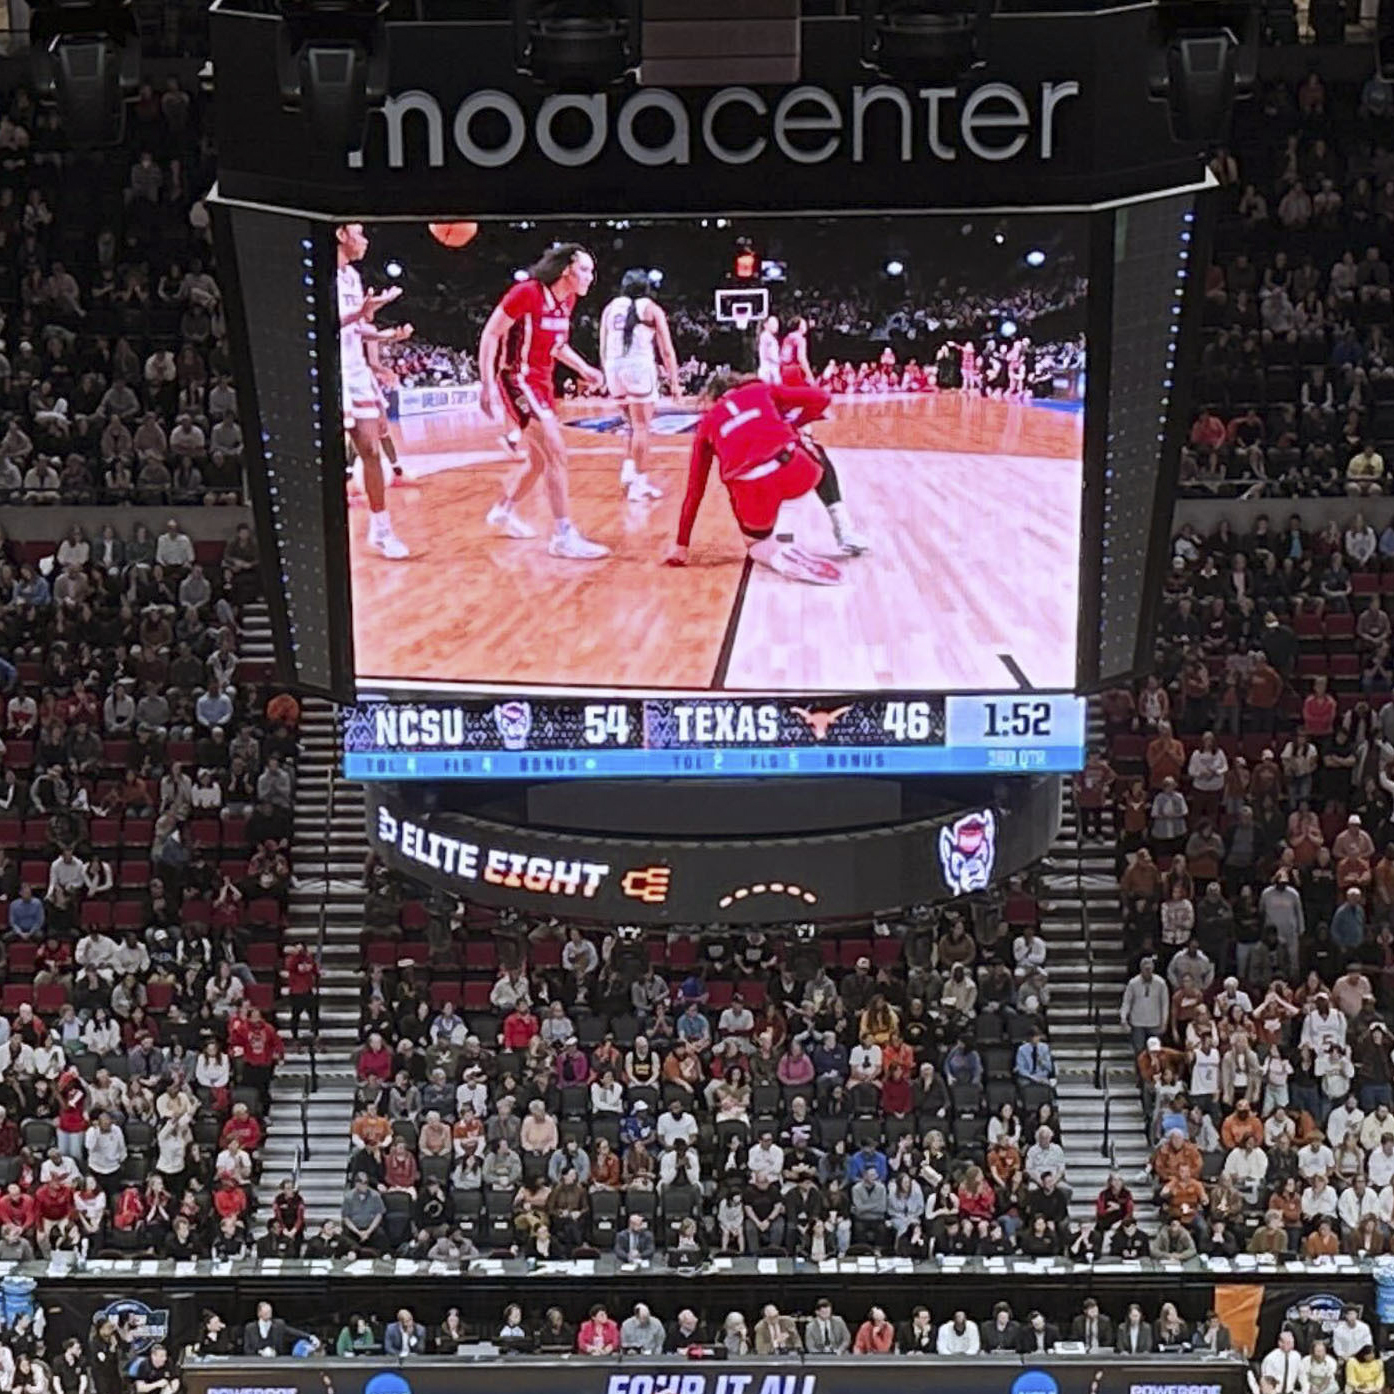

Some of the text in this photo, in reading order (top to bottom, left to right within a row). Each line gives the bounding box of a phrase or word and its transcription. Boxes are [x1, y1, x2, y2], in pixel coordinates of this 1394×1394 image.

[376, 707, 464, 746] NCSU
[584, 705, 630, 745] 54
[673, 706, 778, 742] TEXAS
[883, 702, 931, 741] 46
[983, 702, 1051, 737] 1:52
[401, 821, 610, 897] ELITE EIGHT
